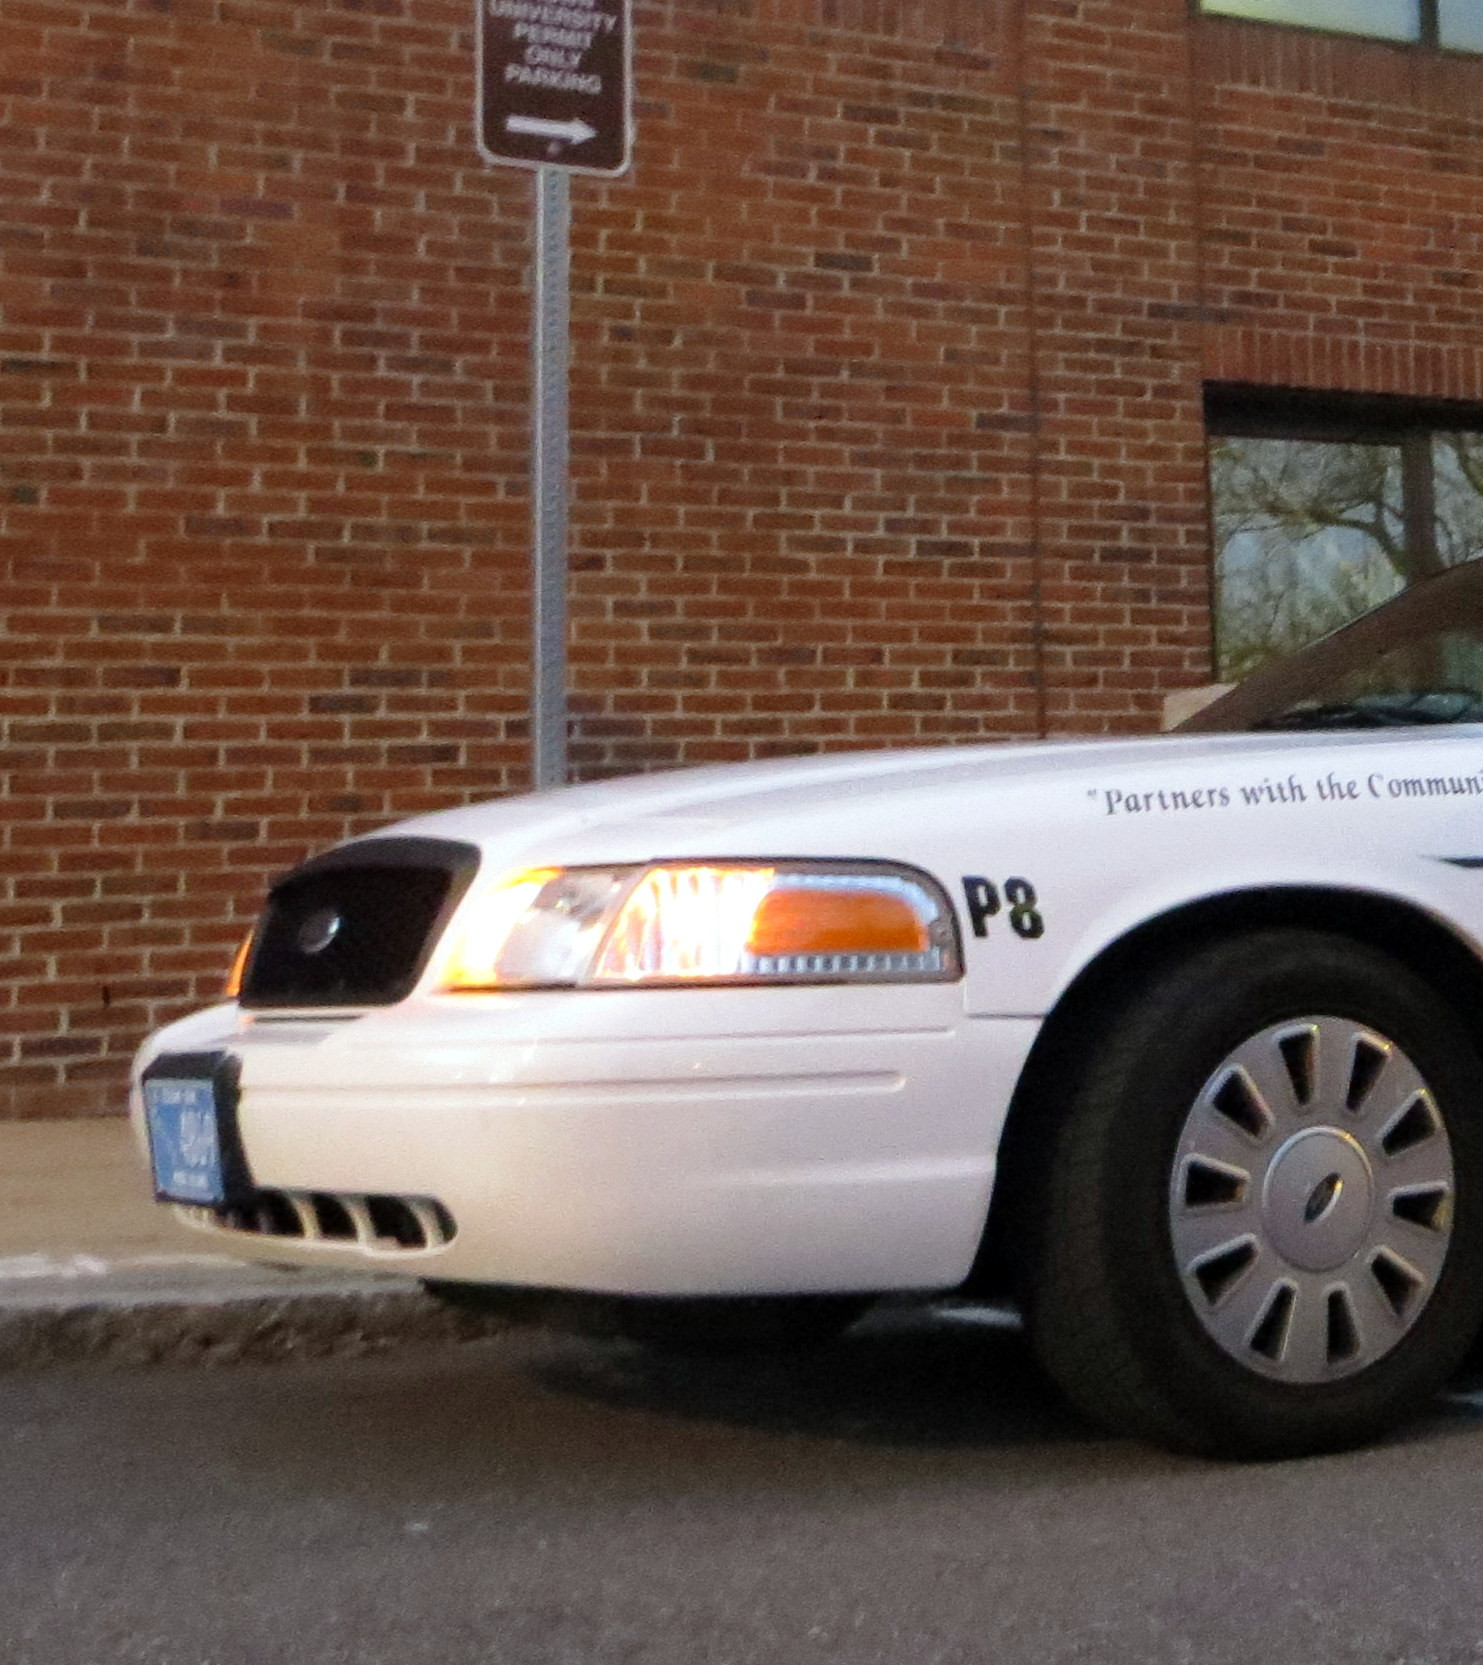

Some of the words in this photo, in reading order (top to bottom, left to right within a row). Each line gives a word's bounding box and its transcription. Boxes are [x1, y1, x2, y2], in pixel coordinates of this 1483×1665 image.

[488, 0, 617, 31] UNIVERSITY
[512, 22, 594, 47] PERMIT
[524, 45, 582, 68] ONLY
[504, 63, 602, 95] PARKING
[1240, 774, 1307, 806] with
[1315, 770, 1360, 801] the
[961, 875, 1045, 939] P8
